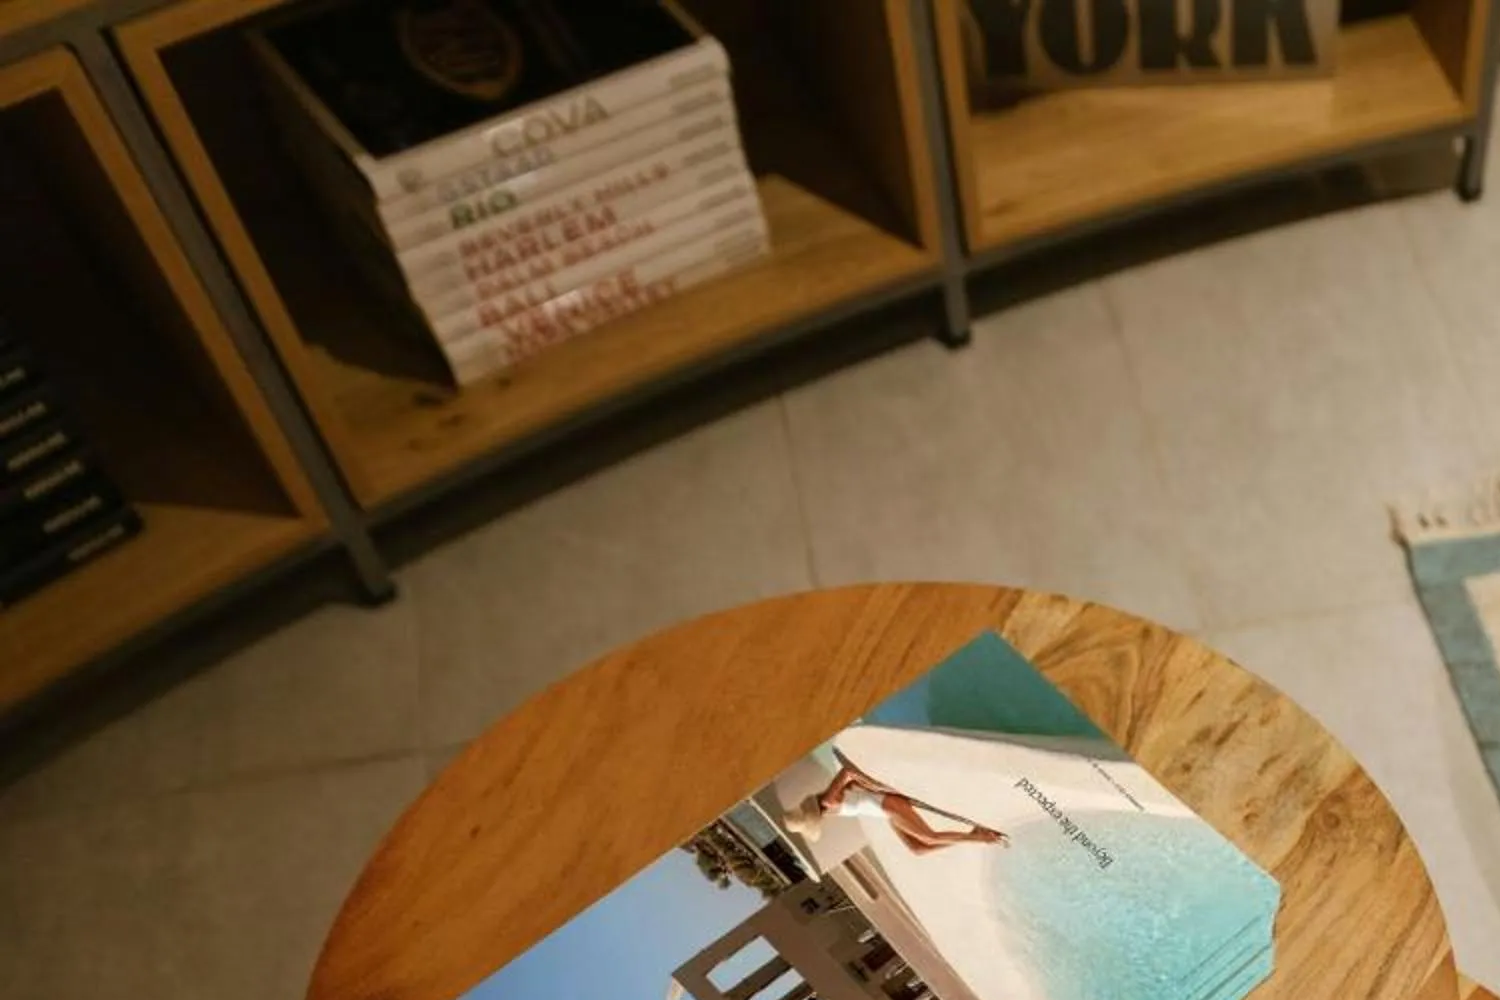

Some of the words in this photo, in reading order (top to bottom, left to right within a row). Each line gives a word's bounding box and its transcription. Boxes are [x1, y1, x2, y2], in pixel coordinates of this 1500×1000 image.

[490, 95, 611, 158] COVA
[451, 189, 518, 231] RIO
[462, 205, 618, 282] HARLEM
[1013, 776, 1064, 820] expected
[1060, 817, 1079, 836] the
[1071, 830, 1114, 870] Beyond
